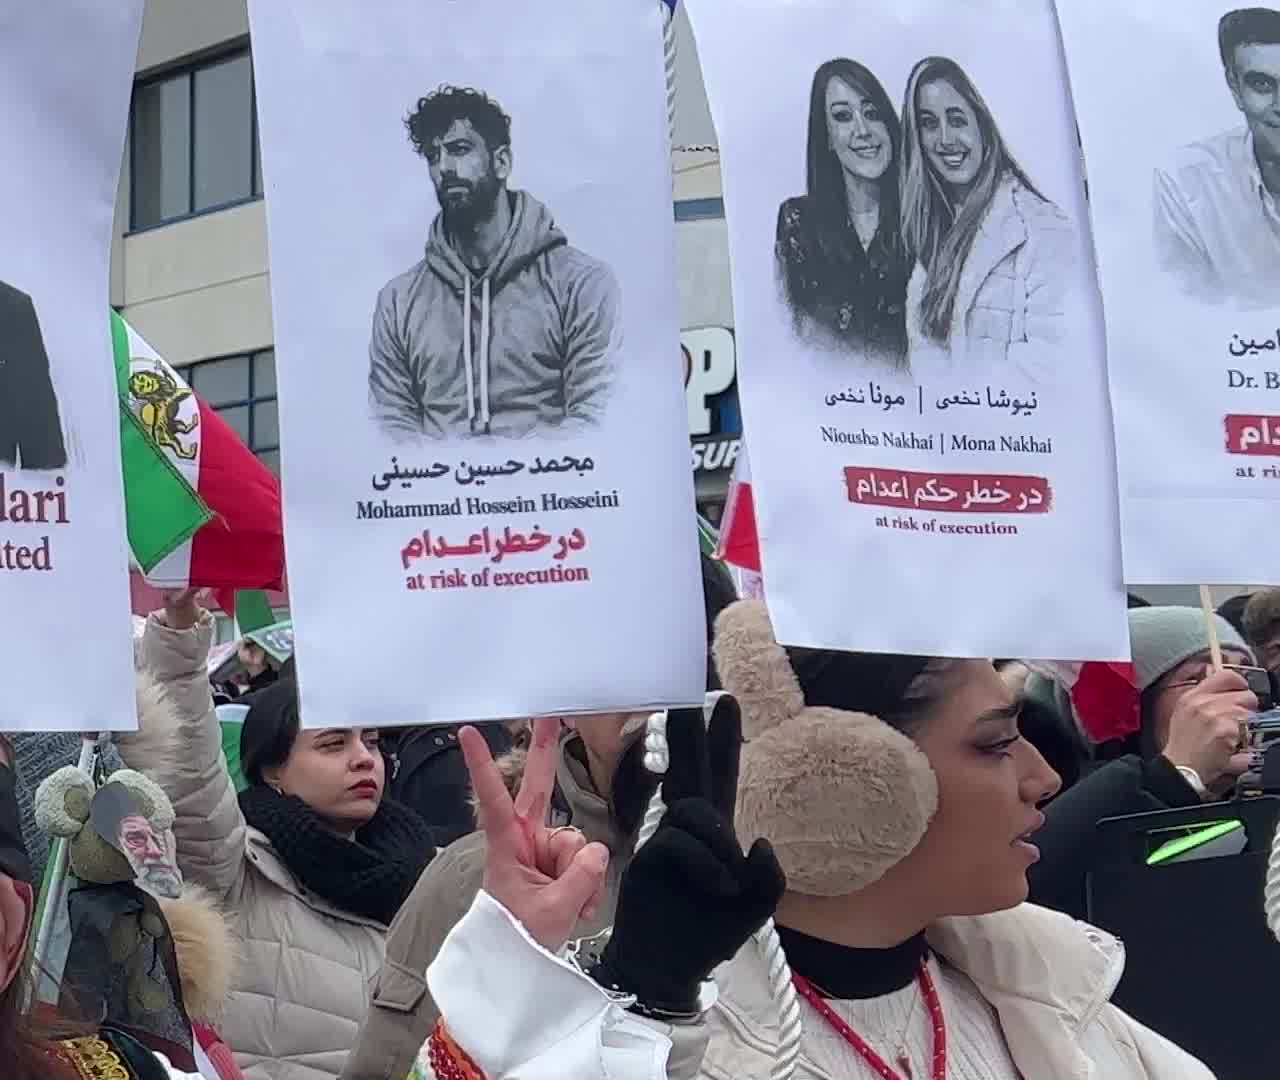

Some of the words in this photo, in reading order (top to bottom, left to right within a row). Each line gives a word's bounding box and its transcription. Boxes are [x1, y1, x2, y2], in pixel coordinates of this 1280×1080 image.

[1226, 369, 1259, 389] Dr.
[820, 426, 880, 447] Niousha
[882, 430, 935, 451] Nakhai
[951, 434, 997, 452] Mona
[1000, 436, 1053, 454] Nakhai
[371, 455, 452, 492] حسینی
[454, 456, 526, 487] حسین
[1235, 465, 1256, 479] at
[855, 473, 910, 501] اعدام
[914, 478, 959, 508] حکم
[961, 479, 1013, 510] خطر
[1015, 486, 1044, 512] در
[355, 497, 462, 521] Mohammad
[466, 495, 538, 516] Hossein
[541, 489, 620, 513] Hosseini
[874, 516, 890, 528] at
[891, 516, 920, 532] risk
[922, 518, 938, 534] of
[939, 520, 1019, 536] execution
[405, 573, 425, 591] at
[430, 567, 470, 589] risk
[471, 566, 491, 588] of
[493, 563, 590, 587] execution
